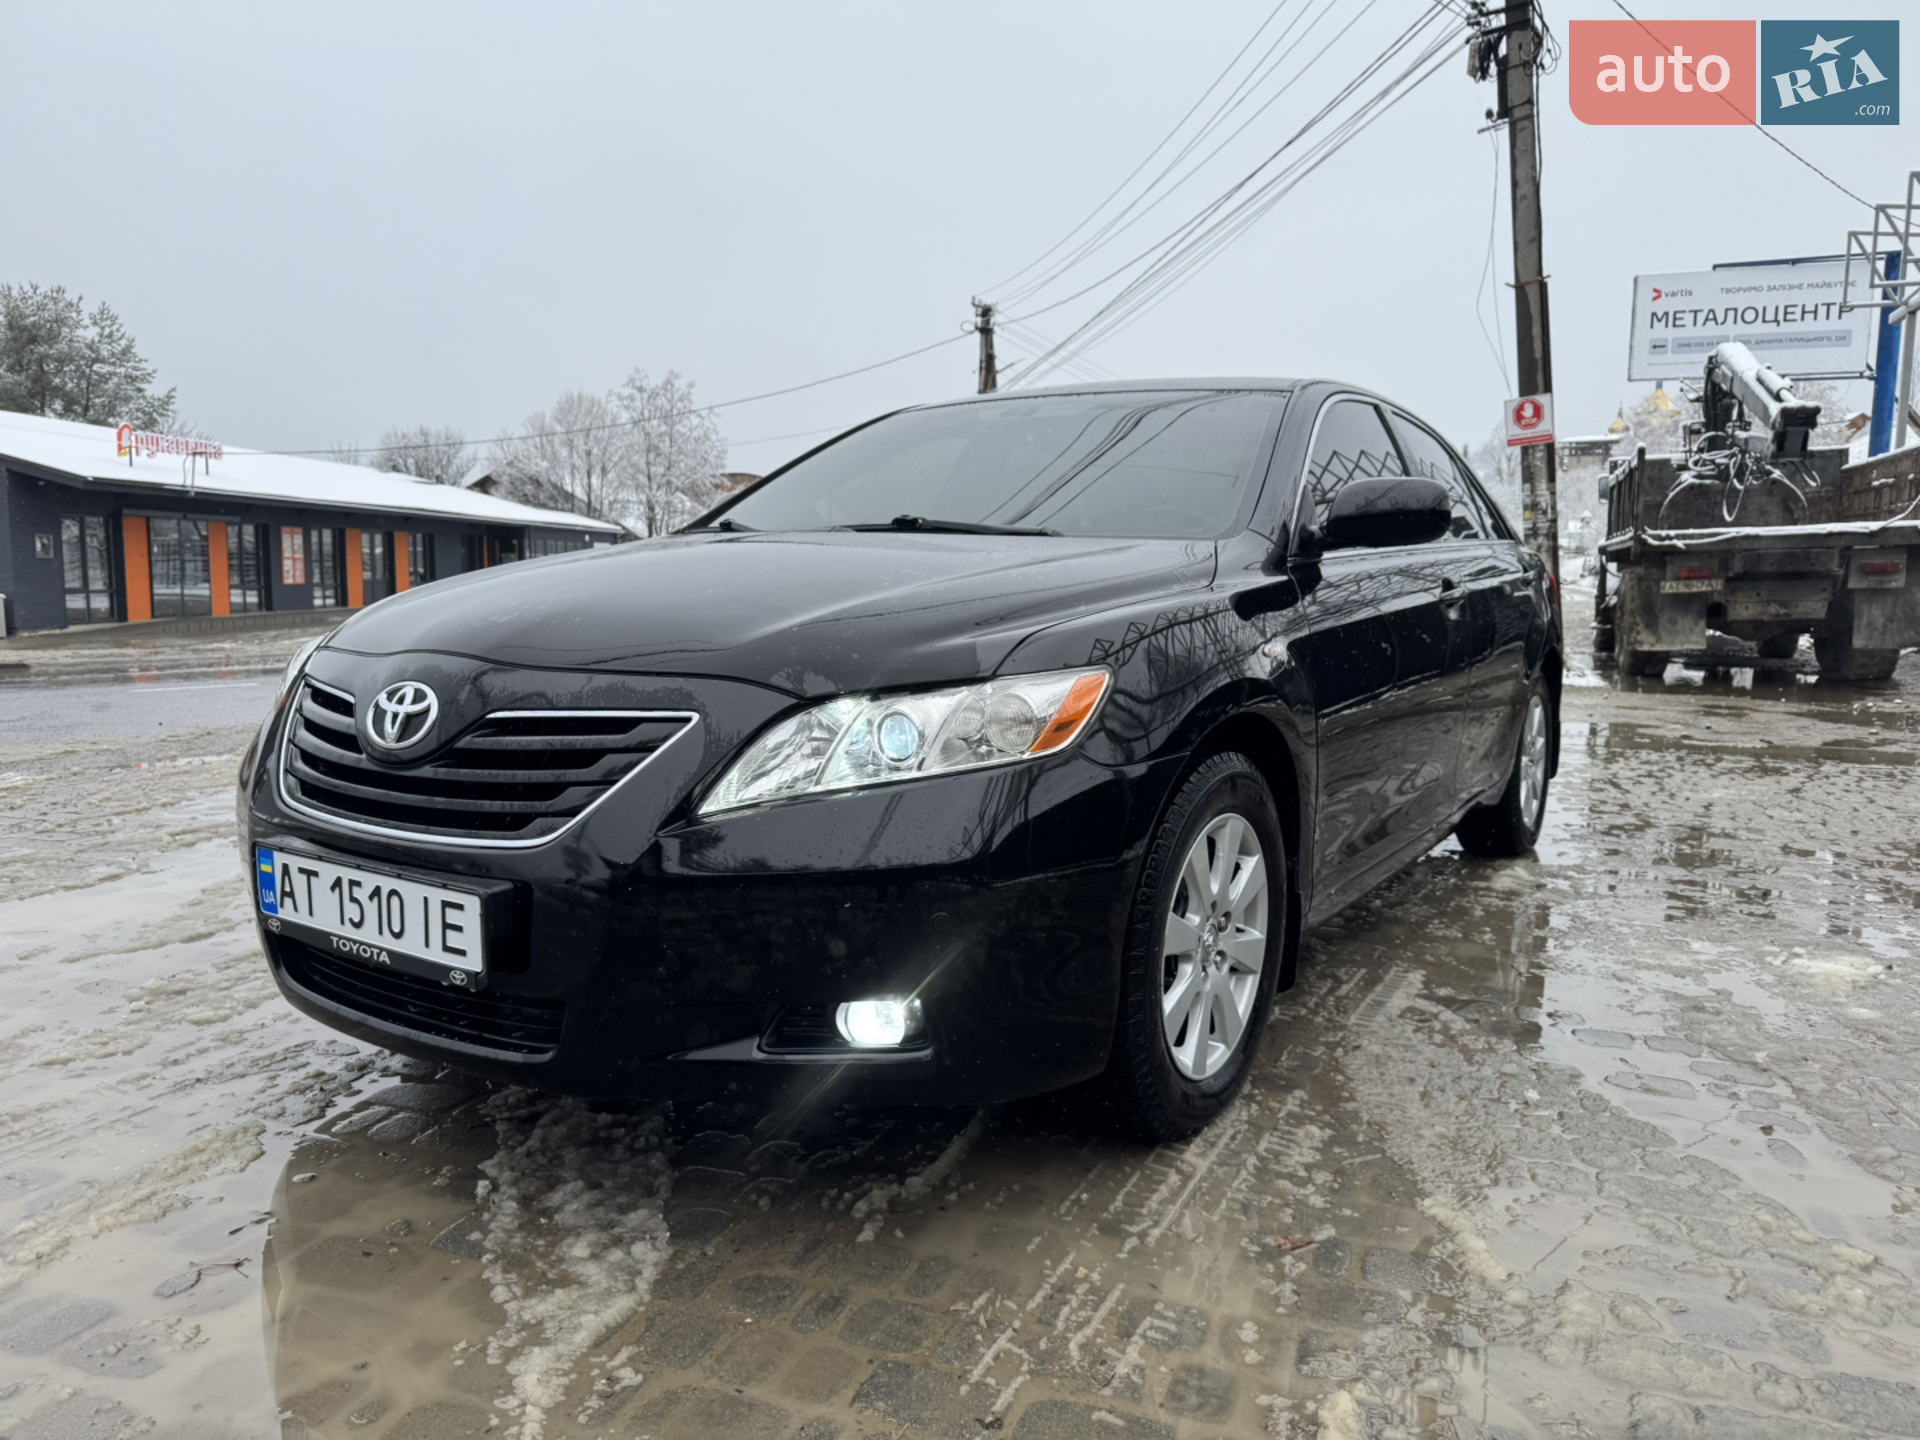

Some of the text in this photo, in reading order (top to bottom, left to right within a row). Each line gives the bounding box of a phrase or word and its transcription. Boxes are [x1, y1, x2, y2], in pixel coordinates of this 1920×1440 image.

[1664, 288, 1693, 298] vartis
[1719, 285, 1764, 294] ТВОРИМО
[1765, 283, 1805, 293] ЗАЛІЗНЕ
[1650, 302, 1854, 330] МЕТАЛОЦЕНТР
[262, 888, 277, 906] UA
[279, 862, 467, 958] AT 1510 IE
[330, 935, 391, 965] TOYOTA
